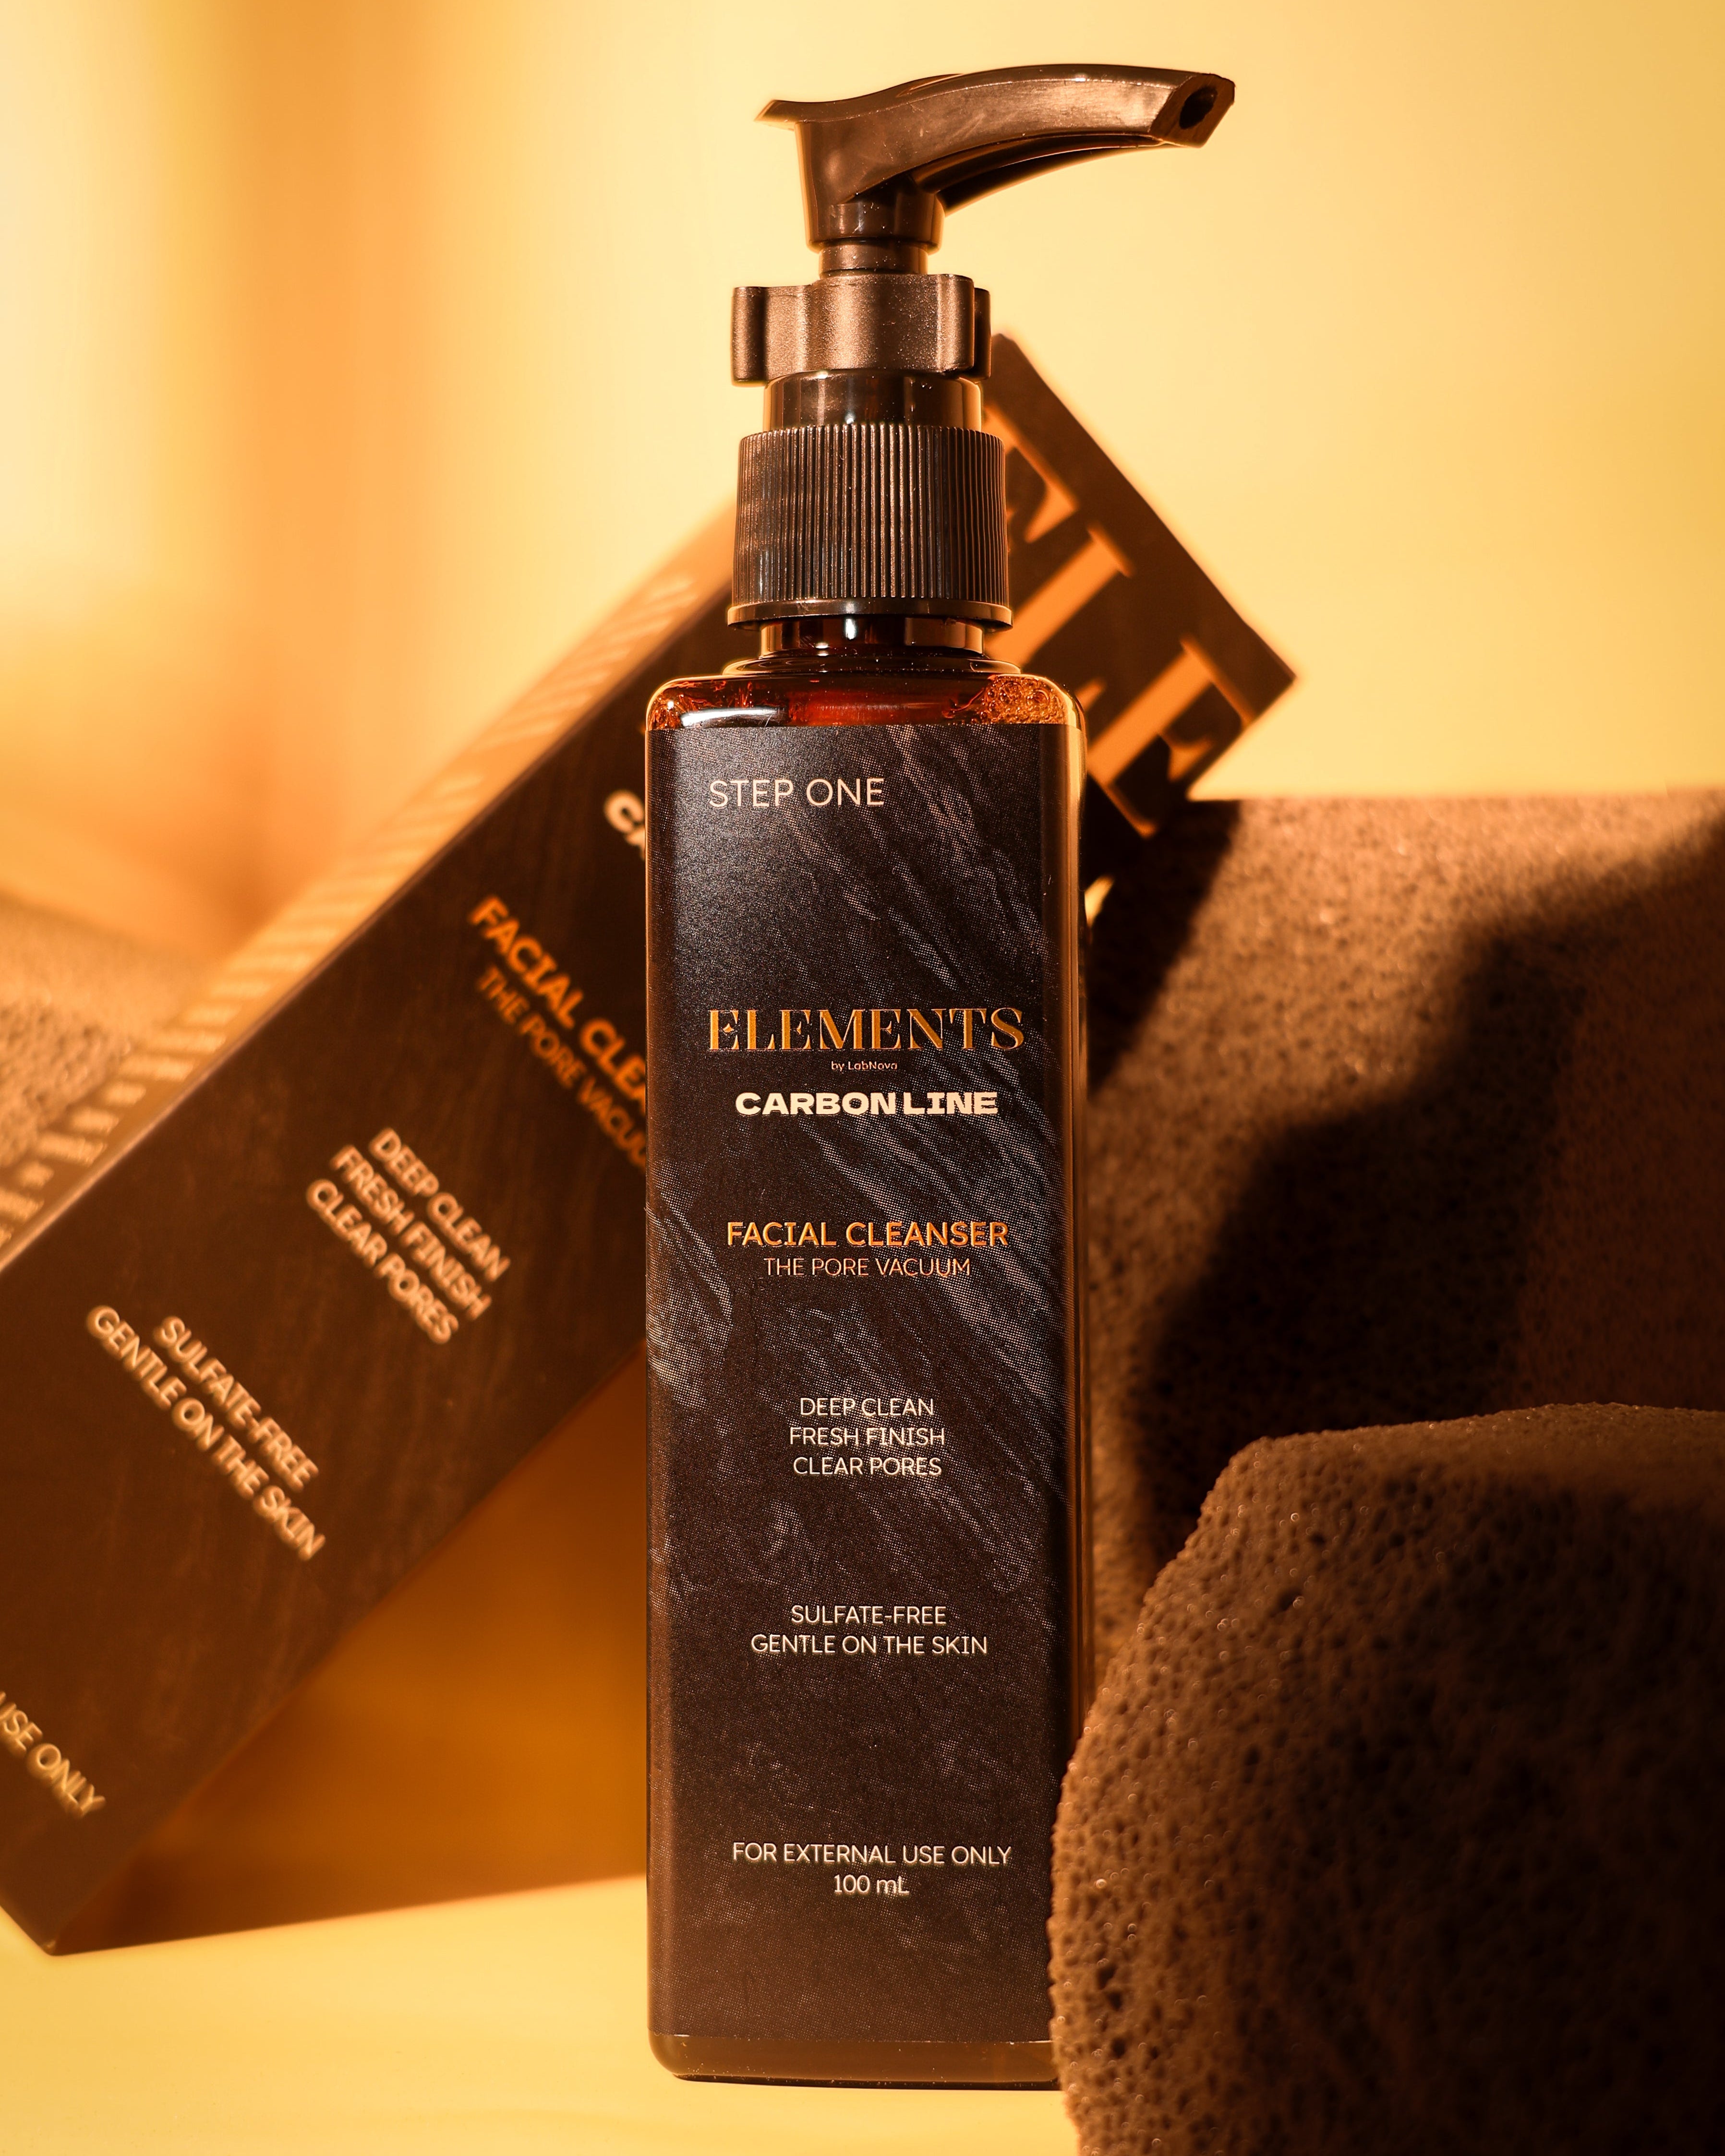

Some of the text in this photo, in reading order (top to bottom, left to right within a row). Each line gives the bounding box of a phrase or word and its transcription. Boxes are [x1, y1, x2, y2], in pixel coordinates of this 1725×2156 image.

[709, 777, 885, 808] STEP ONE
[467, 895, 585, 1030] FACIAL
[478, 966, 529, 1027] THE
[519, 1010, 586, 1090] PORE
[708, 1007, 1025, 1051] ELEMENTS
[831, 1060, 898, 1072] by LabNova
[735, 1091, 999, 1116] CARBON LINE
[368, 1127, 511, 1282] DEEP CLEAN
[329, 1144, 492, 1321] FRESH FINISH
[727, 1221, 1010, 1247] FACIAL CLEANSER
[305, 1178, 459, 1344] CLEAR PORES
[763, 1258, 971, 1277] THE PORE VACUUM
[153, 1316, 319, 1492] SULFATE-FREE
[800, 1397, 934, 1416] DEEP CLEAN
[85, 1305, 326, 1561] GENTLE ON THE SKIN
[789, 1427, 945, 1446] FRESH FINISH
[793, 1456, 942, 1476] CLEAR PORES
[791, 1605, 946, 1625] SULFATE-FREE
[751, 1634, 988, 1655] GENTLE ON THE SKIN
[26, 1743, 107, 1819] ONLY
[733, 1842, 1012, 1866] FOR EXTERNAL USE ONLY
[833, 1874, 910, 1896] 100 mL
